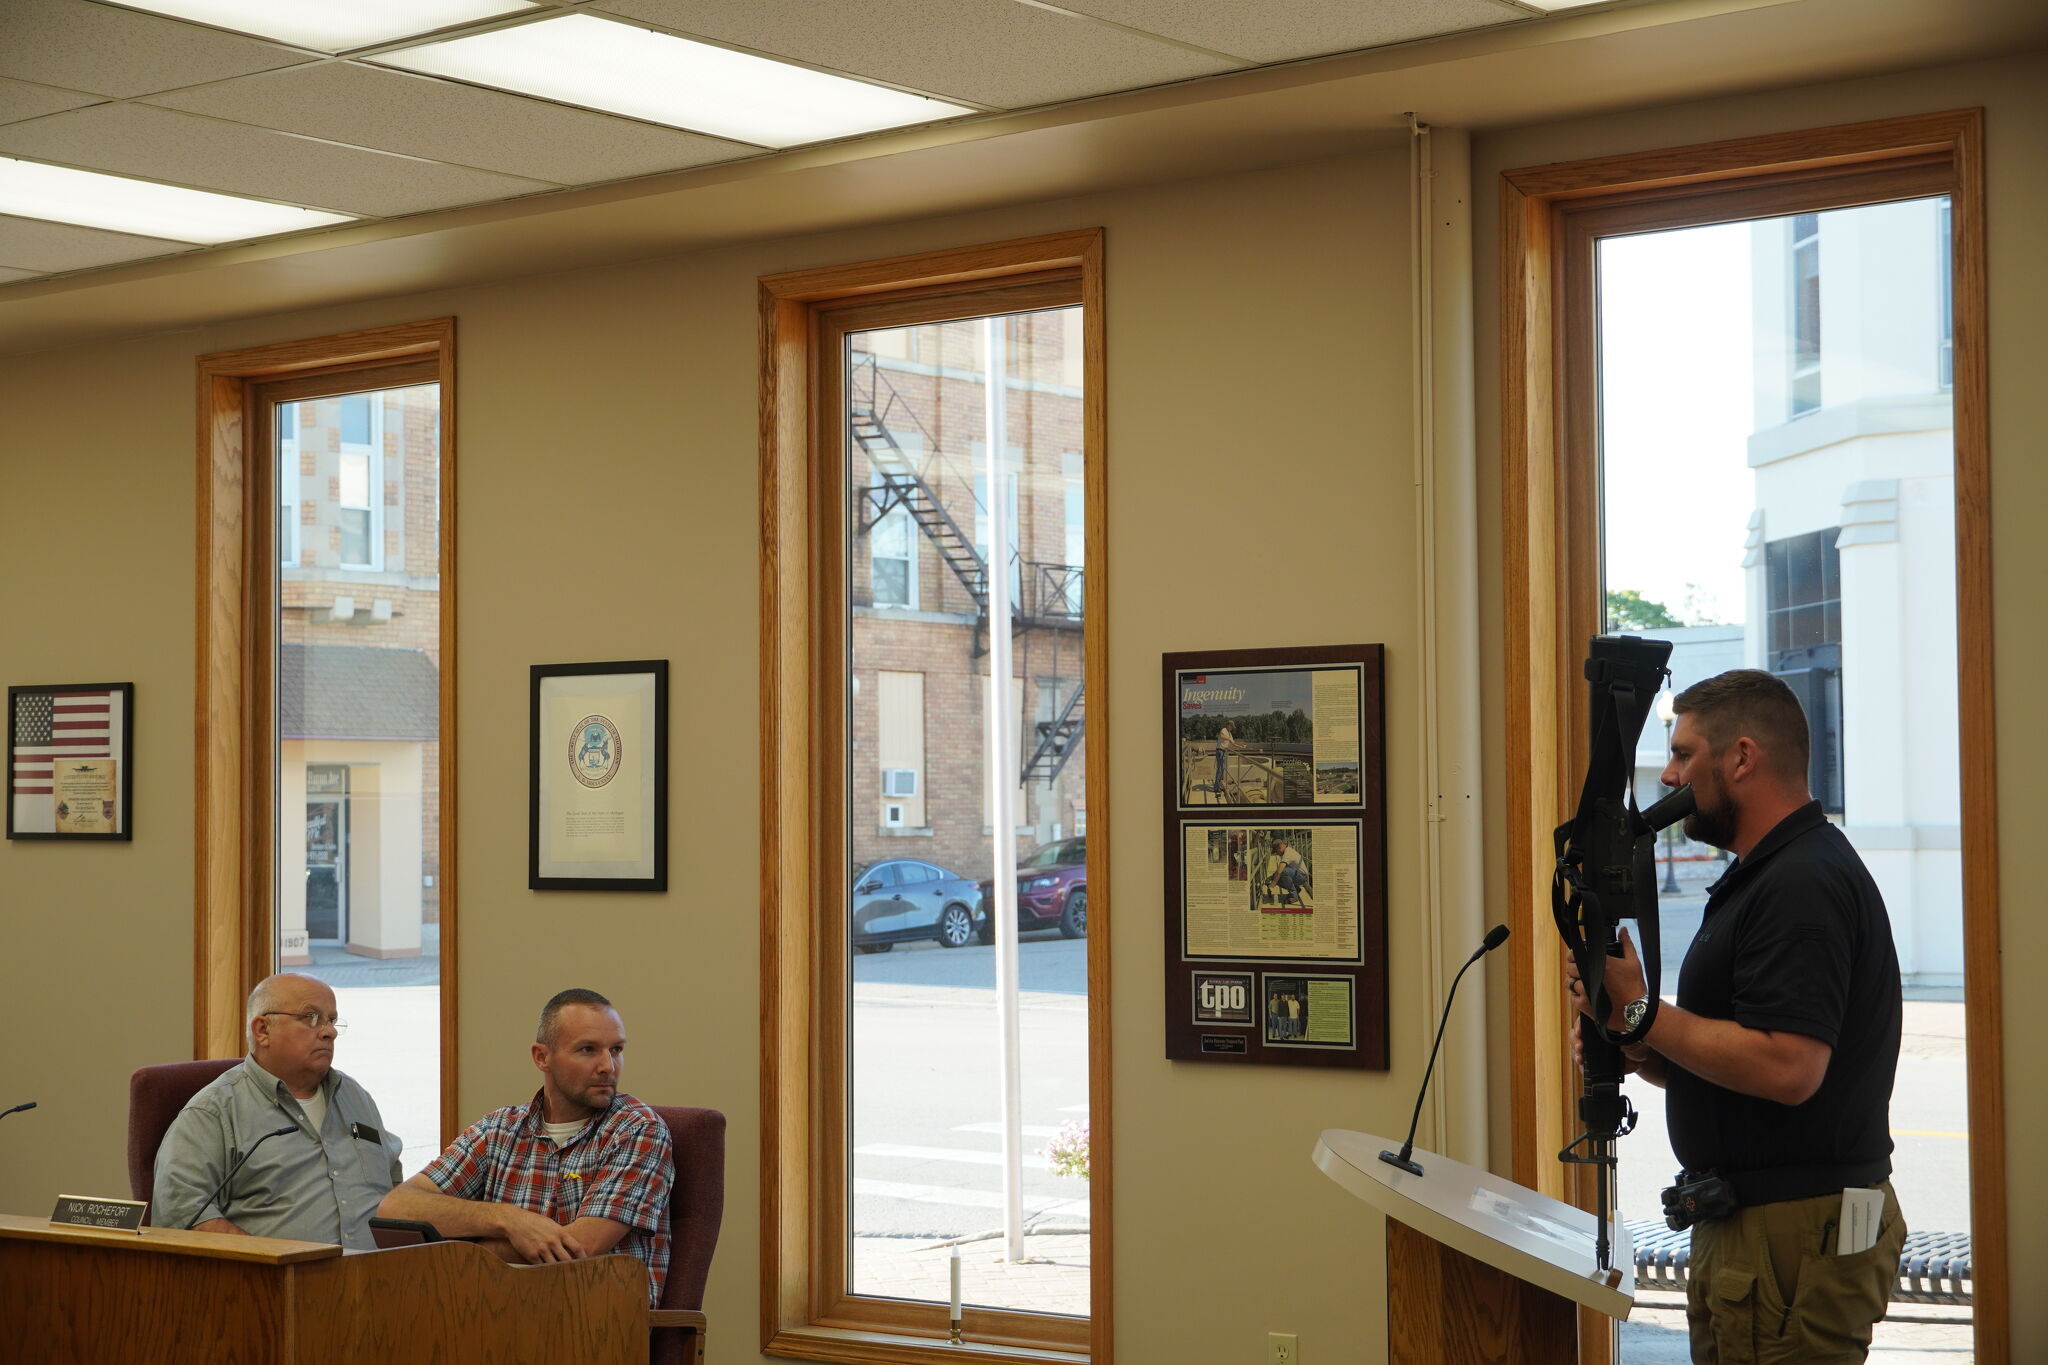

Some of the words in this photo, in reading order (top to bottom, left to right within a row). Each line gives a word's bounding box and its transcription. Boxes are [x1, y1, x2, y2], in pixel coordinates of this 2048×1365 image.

[1183, 686, 1246, 704] Ingenuity
[1199, 979, 1245, 1018] tpo
[69, 1203, 86, 1213] NICK
[88, 1204, 130, 1216] ROCHEFORT
[71, 1216, 92, 1225] COUNCIL
[97, 1218, 119, 1227] MEMBER
